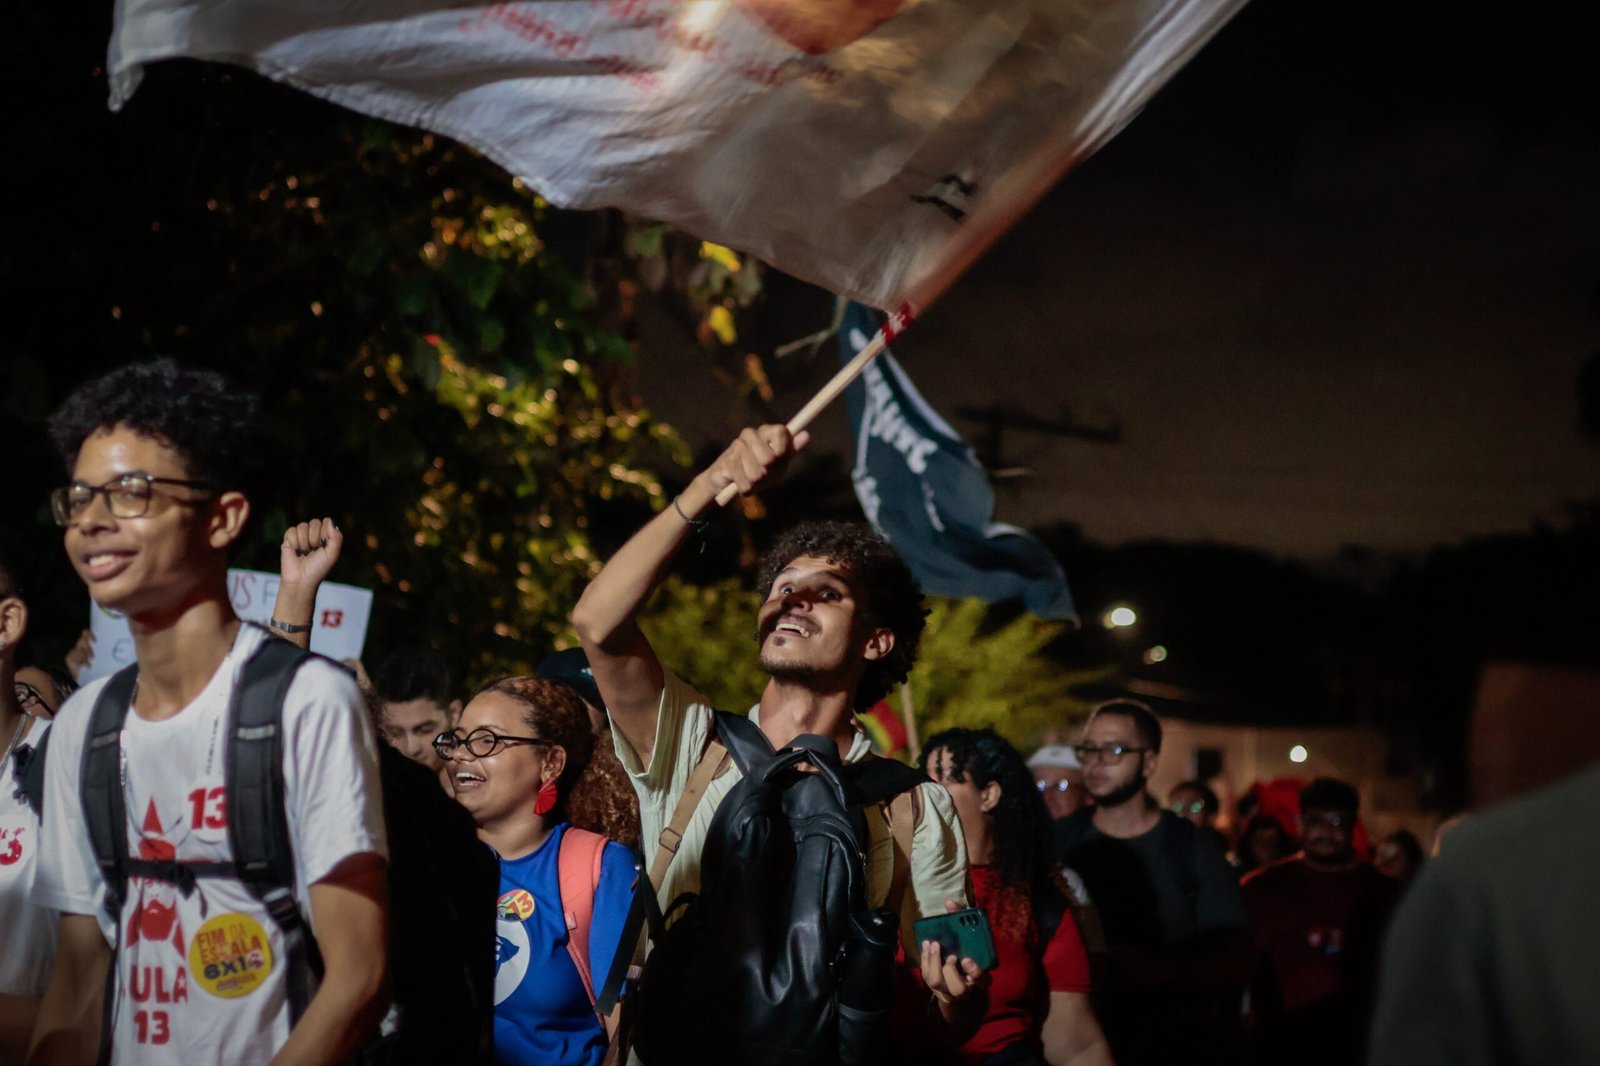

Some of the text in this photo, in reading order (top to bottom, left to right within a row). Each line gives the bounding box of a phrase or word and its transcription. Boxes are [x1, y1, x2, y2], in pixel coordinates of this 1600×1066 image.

[188, 786, 228, 830] 13
[196, 927, 226, 949] FIM
[134, 1010, 170, 1044] 13
